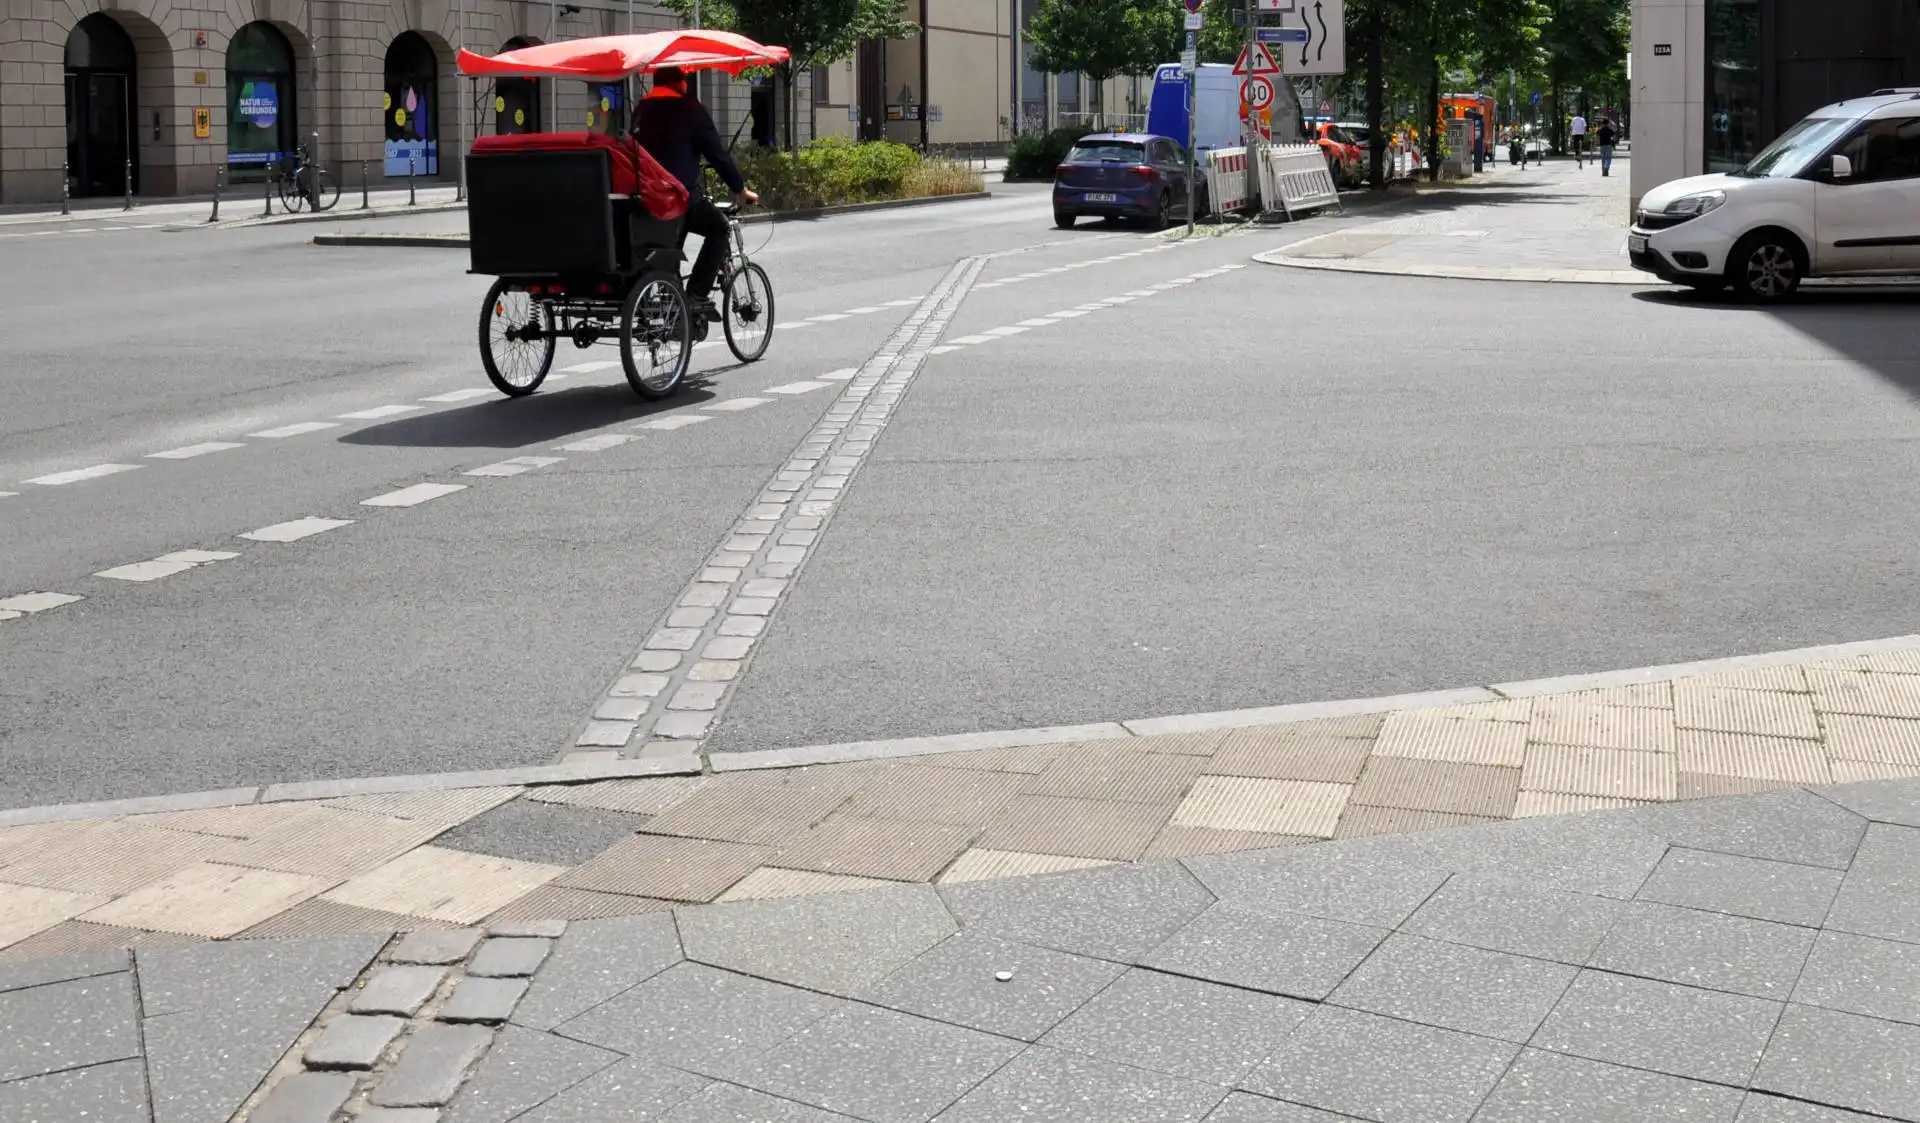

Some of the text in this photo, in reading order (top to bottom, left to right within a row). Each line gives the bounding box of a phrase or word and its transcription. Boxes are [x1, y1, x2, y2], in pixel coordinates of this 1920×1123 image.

[1160, 69, 1184, 80] GLS
[240, 98, 260, 106] NATUR
[240, 107, 277, 115] VERBUNDEN
